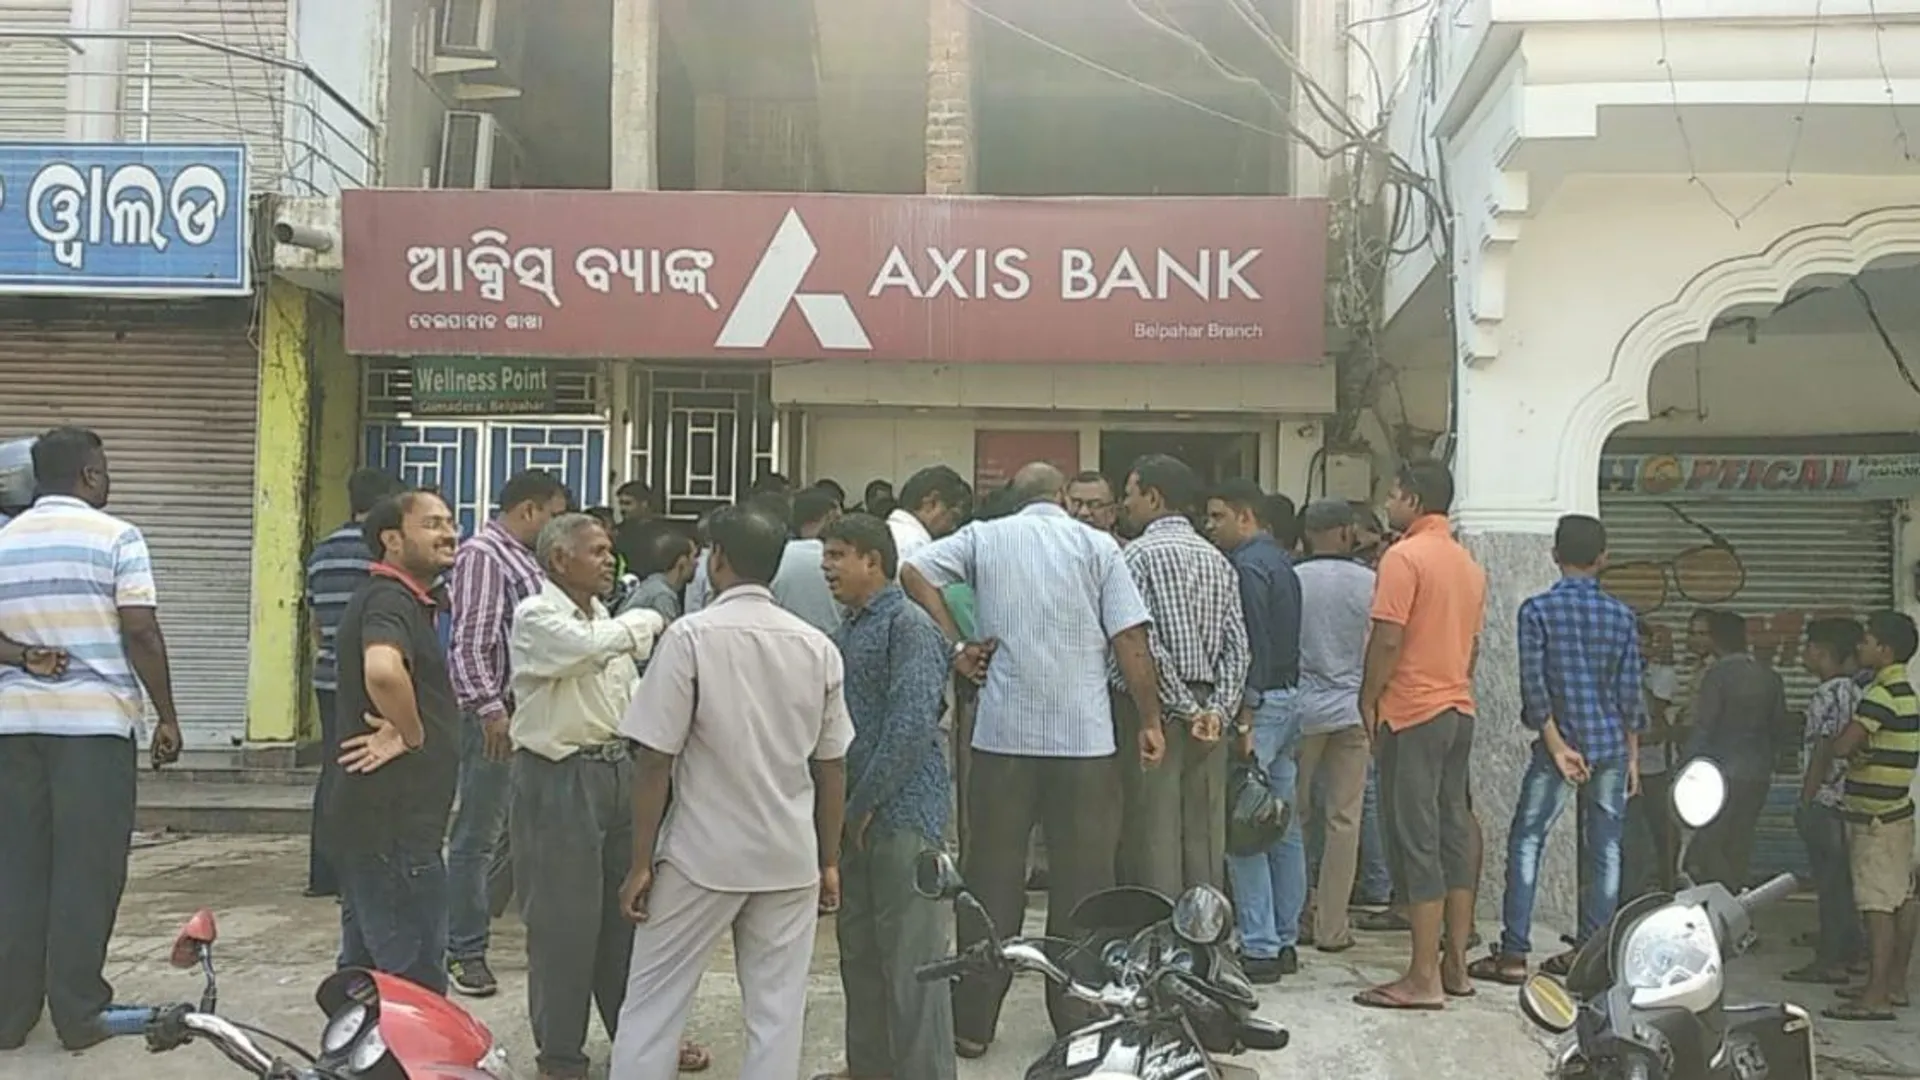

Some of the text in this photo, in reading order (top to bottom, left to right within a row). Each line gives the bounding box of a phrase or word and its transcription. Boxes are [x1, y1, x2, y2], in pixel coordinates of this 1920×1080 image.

[868, 244, 1264, 302] AXIS BANK
[1134, 321, 1263, 342] Belpahar Branch
[416, 365, 547, 393] Wellness Point
